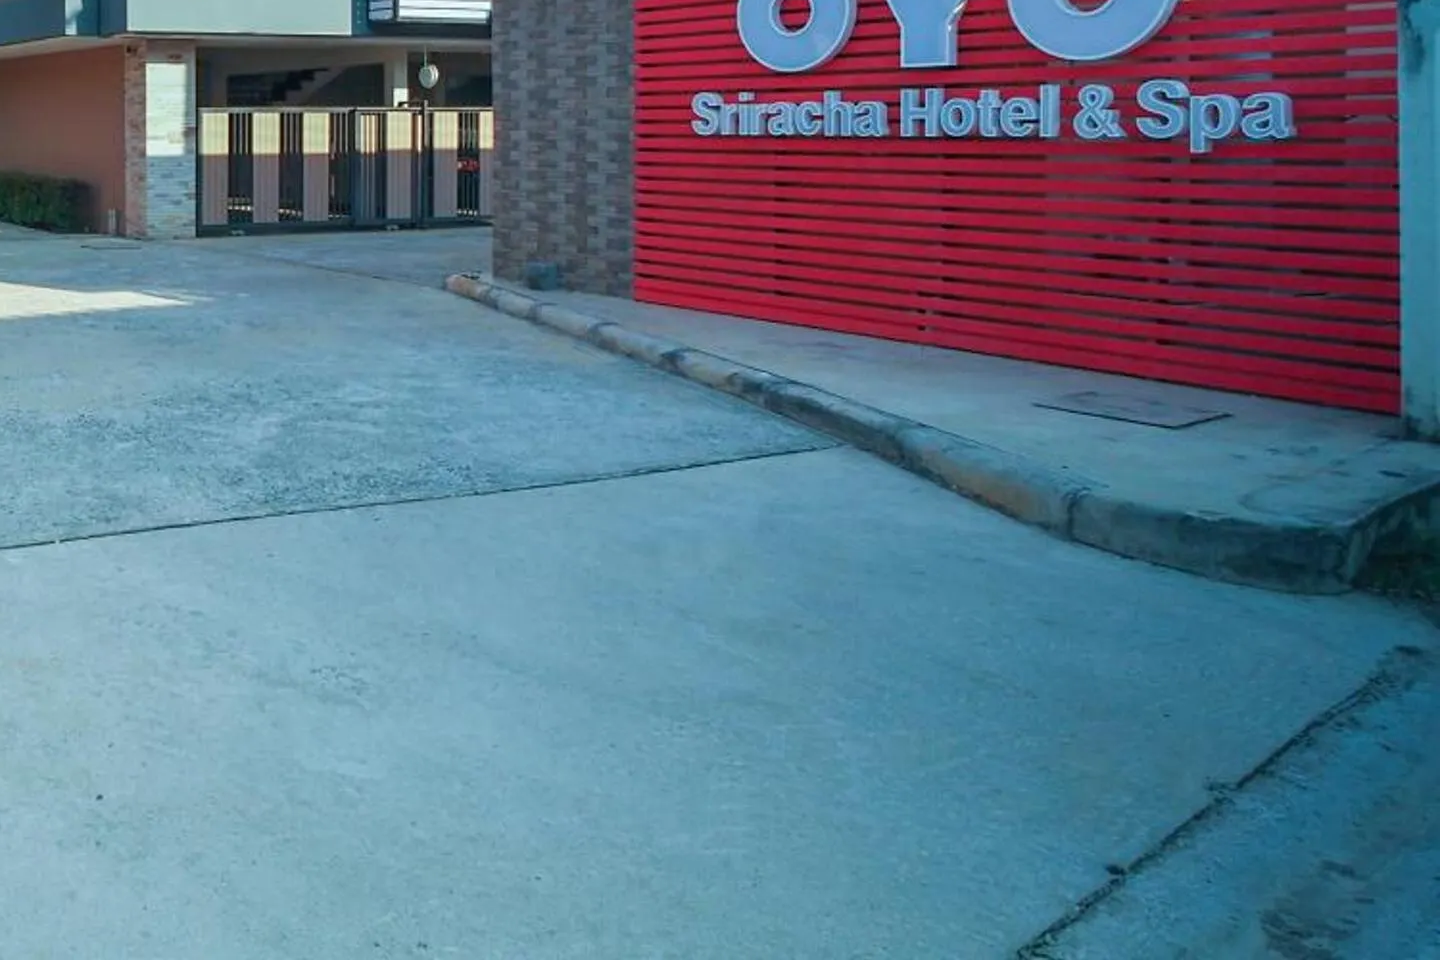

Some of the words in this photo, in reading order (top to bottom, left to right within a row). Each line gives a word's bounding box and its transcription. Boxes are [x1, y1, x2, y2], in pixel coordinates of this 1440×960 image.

[691, 91, 889, 136] Sriracha
[900, 83, 1060, 138] Hotel
[1072, 83, 1127, 139] &
[1135, 78, 1298, 154] Spa
